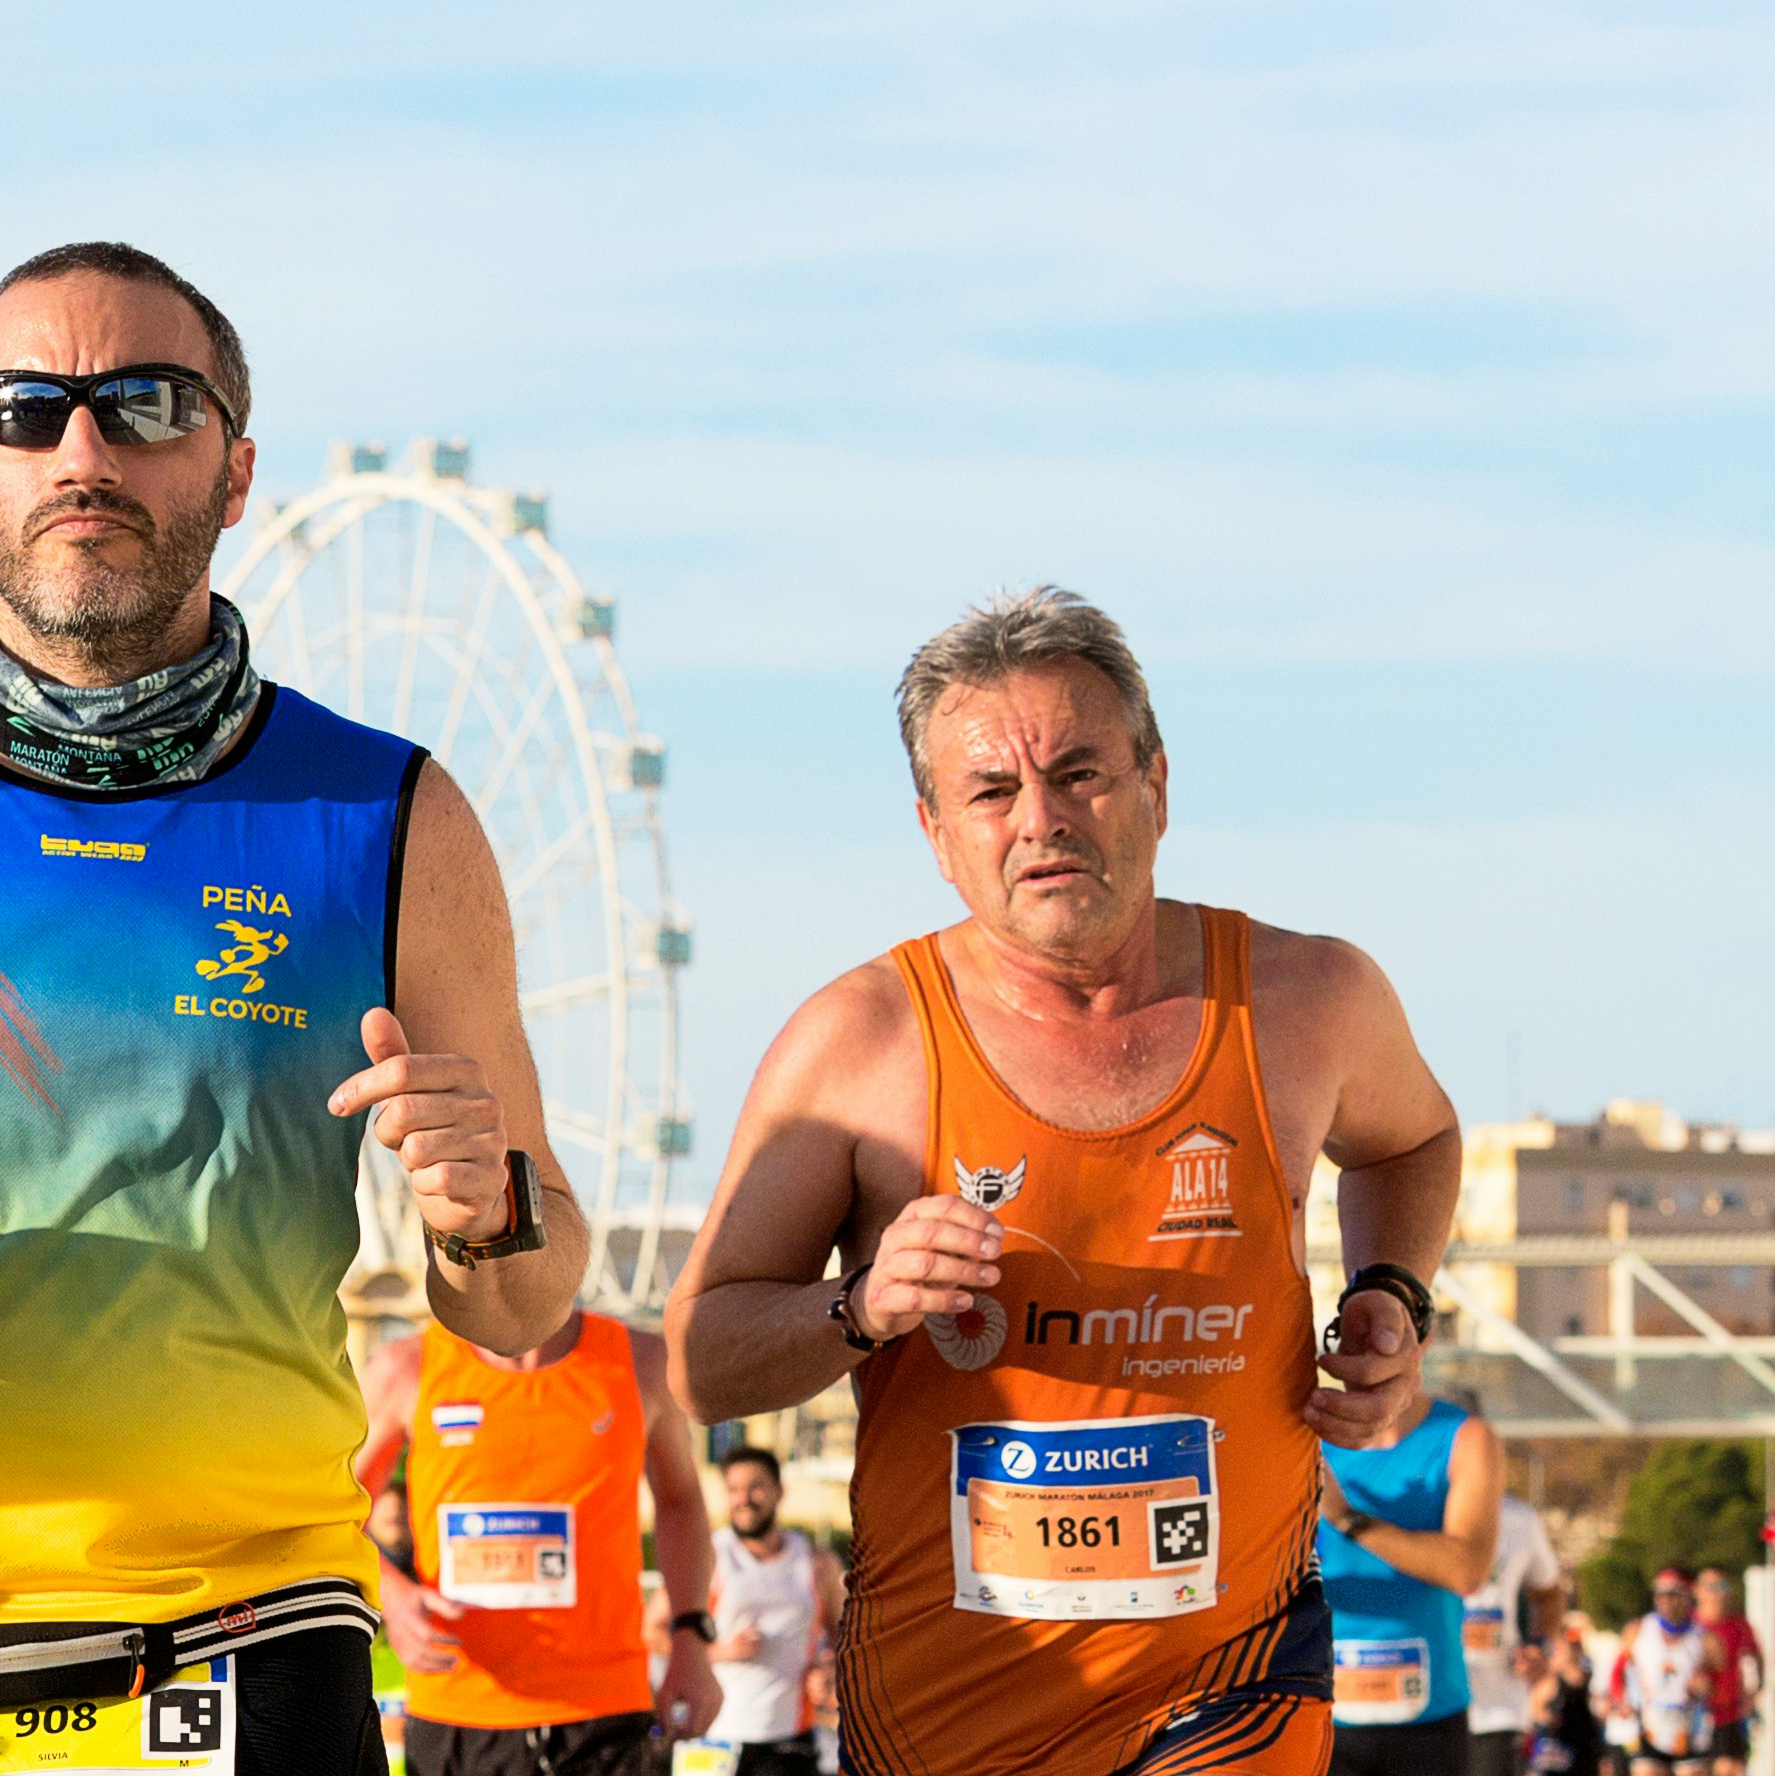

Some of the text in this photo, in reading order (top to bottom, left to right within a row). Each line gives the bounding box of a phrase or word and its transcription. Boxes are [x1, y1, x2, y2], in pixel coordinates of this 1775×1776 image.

[10, 740, 69, 766] MARATÓN
[202, 884, 292, 917] PEÑA
[174, 995, 308, 1029] EL COYOTE
[1170, 1157, 1228, 1203] ALA 14
[1045, 1446, 1148, 1473] ZURICH
[1036, 1515, 1120, 1547] 1861
[15, 1702, 98, 1738] 908
[38, 1752, 69, 1762] SILVIA
[179, 1759, 189, 1768] M
